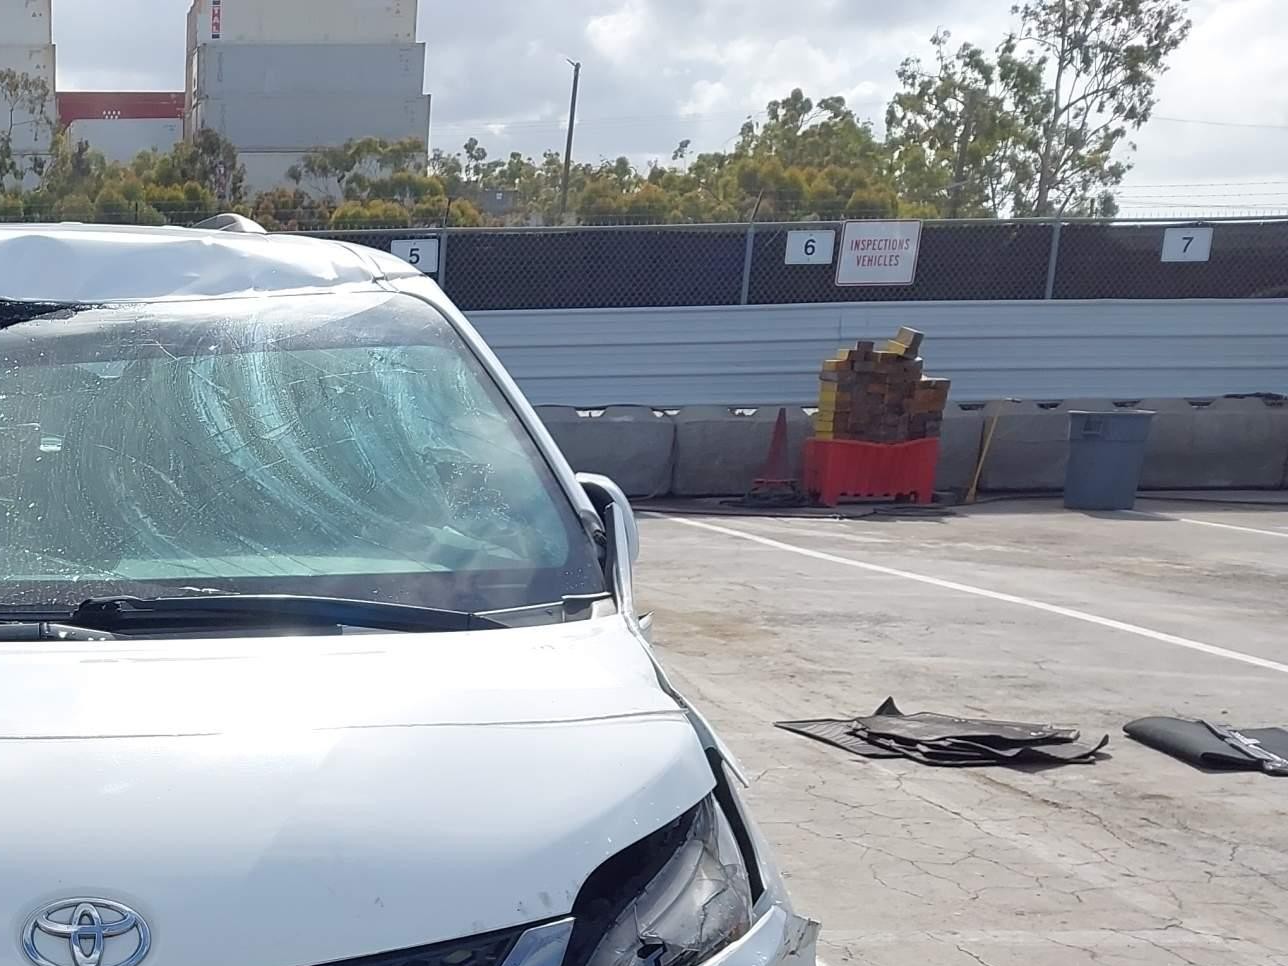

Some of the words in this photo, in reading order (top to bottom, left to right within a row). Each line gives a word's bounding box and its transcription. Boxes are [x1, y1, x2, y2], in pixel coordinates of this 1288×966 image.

[804, 238, 816, 256] 6
[850, 238, 911, 251] INSPECTIONS
[1182, 236, 1194, 253] 7
[409, 248, 420, 265] 5
[856, 254, 900, 267] VEHICLES
